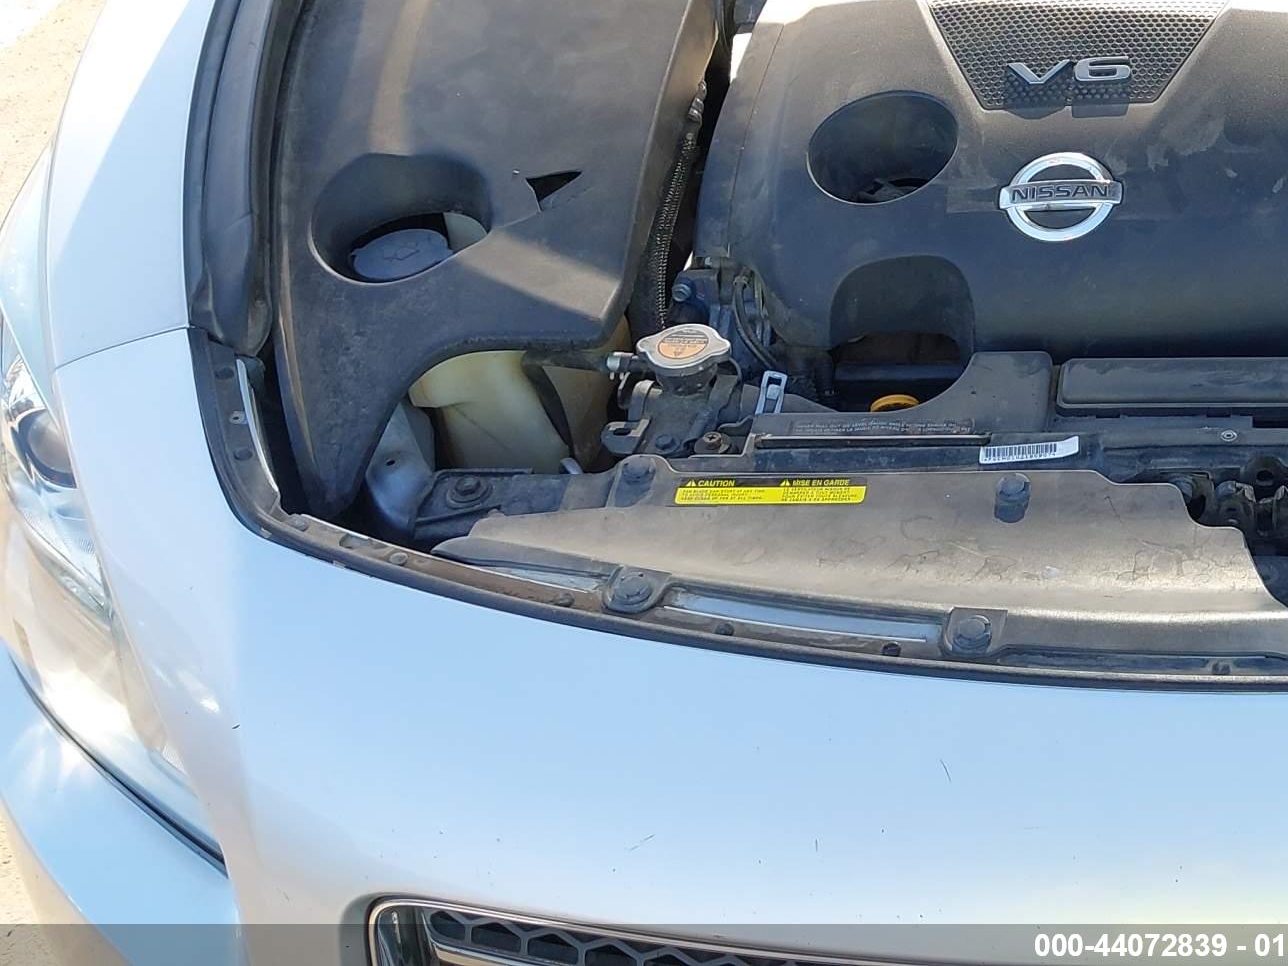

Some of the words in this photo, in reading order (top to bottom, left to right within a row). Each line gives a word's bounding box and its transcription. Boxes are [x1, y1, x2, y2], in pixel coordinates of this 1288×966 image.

[1008, 56, 1132, 84] V6
[1011, 185, 1108, 202] NISSAN
[697, 479, 736, 487] CAUTION
[792, 479, 811, 487] MISE
[811, 479, 823, 487] EN
[823, 479, 851, 487] GARDE
